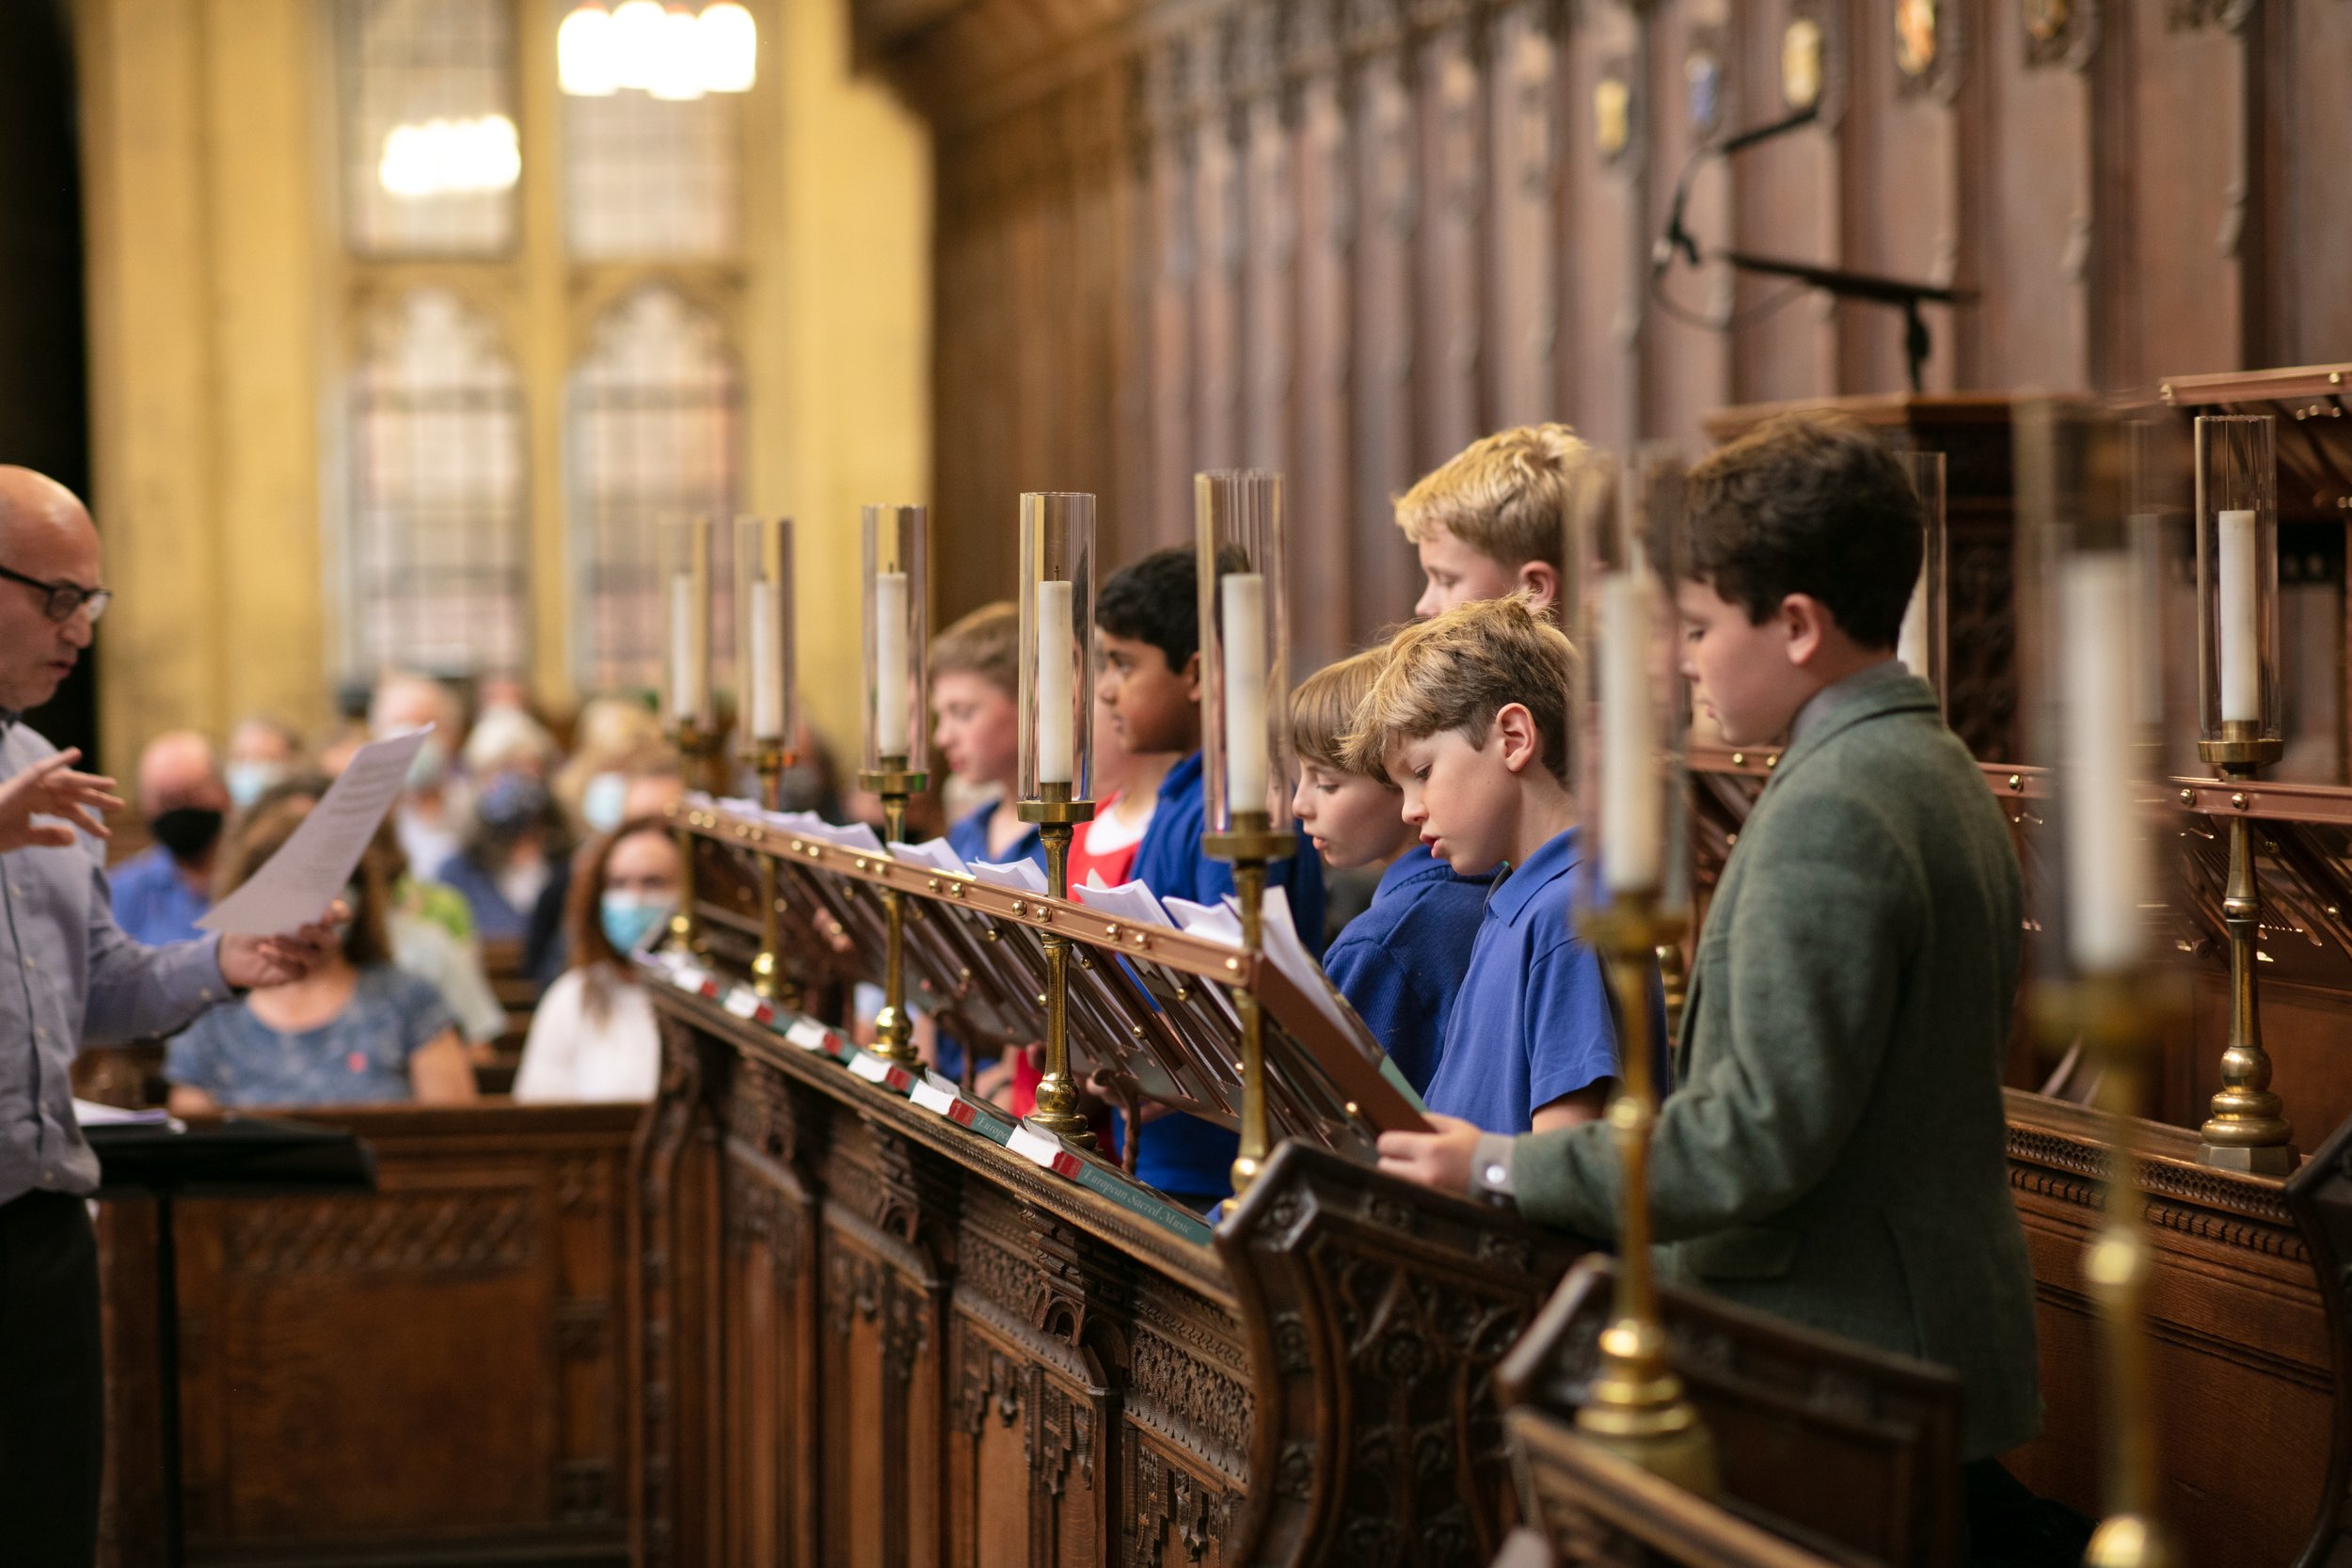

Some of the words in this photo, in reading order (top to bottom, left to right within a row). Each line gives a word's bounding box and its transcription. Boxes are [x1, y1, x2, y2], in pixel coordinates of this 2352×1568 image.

[1084, 1168, 1127, 1200] European
[1127, 1195, 1162, 1217] Sacred
[1159, 1212, 1192, 1233] Music
